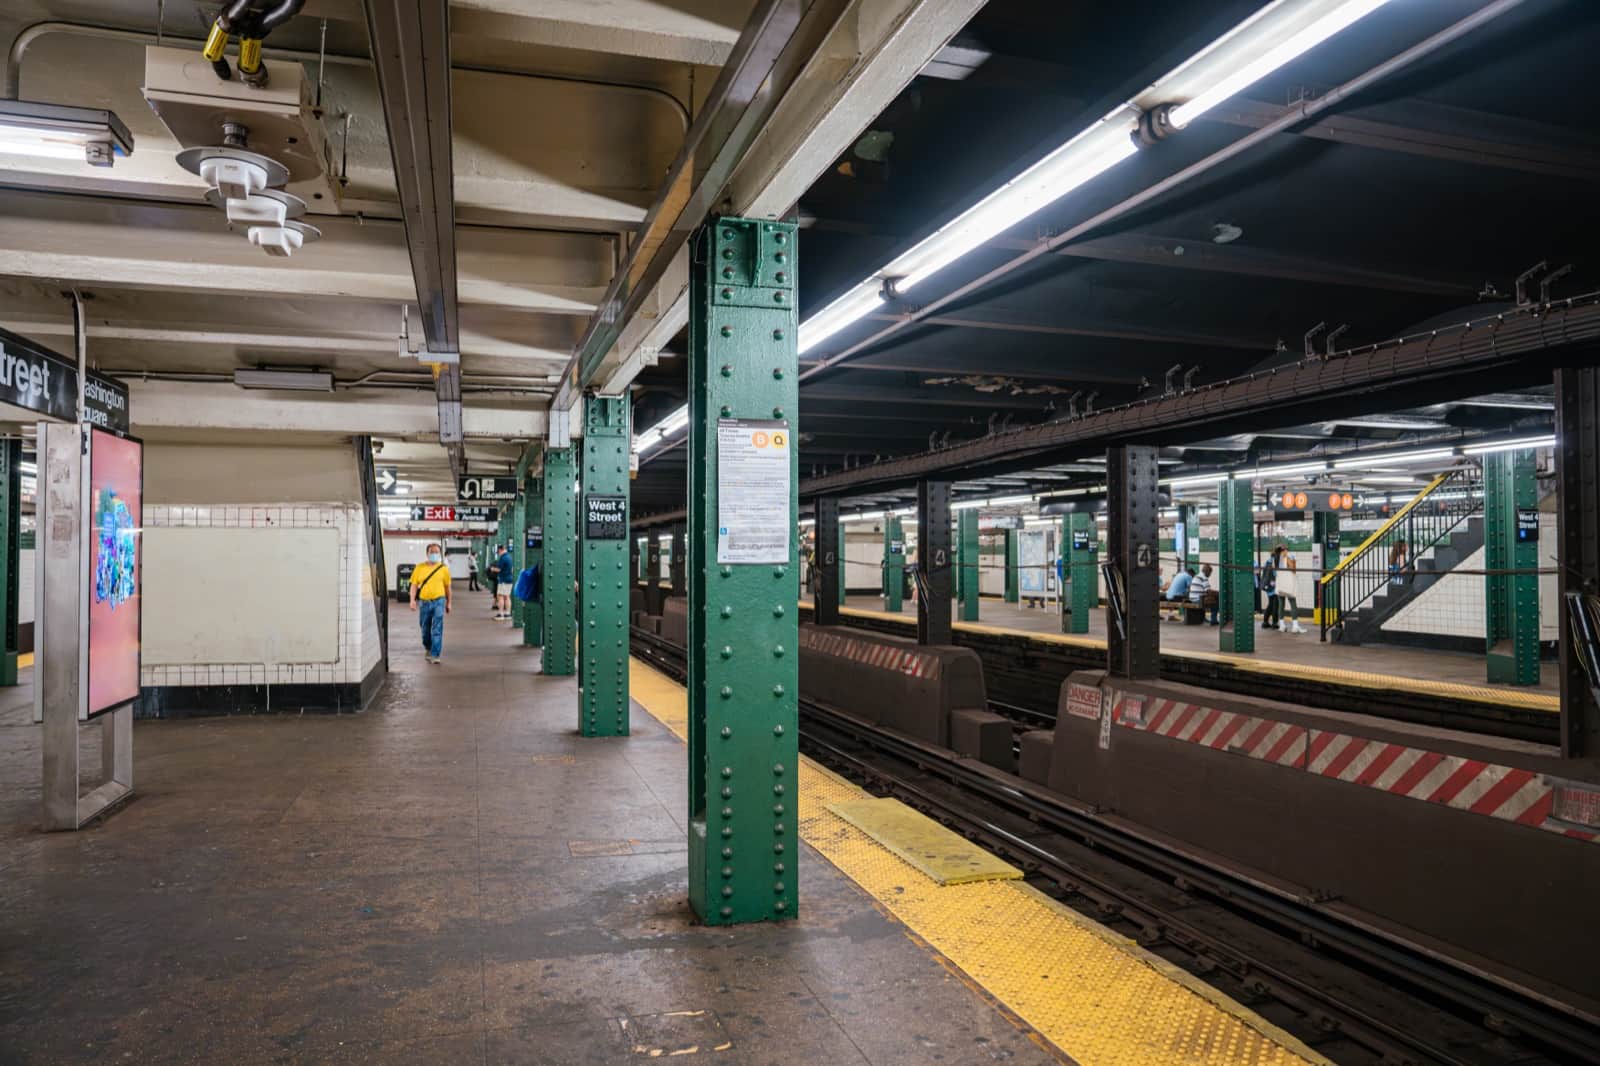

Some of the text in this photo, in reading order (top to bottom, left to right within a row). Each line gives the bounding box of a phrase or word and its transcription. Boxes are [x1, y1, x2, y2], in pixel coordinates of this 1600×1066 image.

[0, 341, 50, 400] treet
[84, 380, 125, 410] ashington
[83, 406, 108, 426] quare
[481, 491, 516, 499] Escalator
[424, 507, 451, 520] Exit
[589, 501, 626, 511] West 4
[589, 512, 622, 522] Street
[1069, 687, 1101, 704] DANGER
